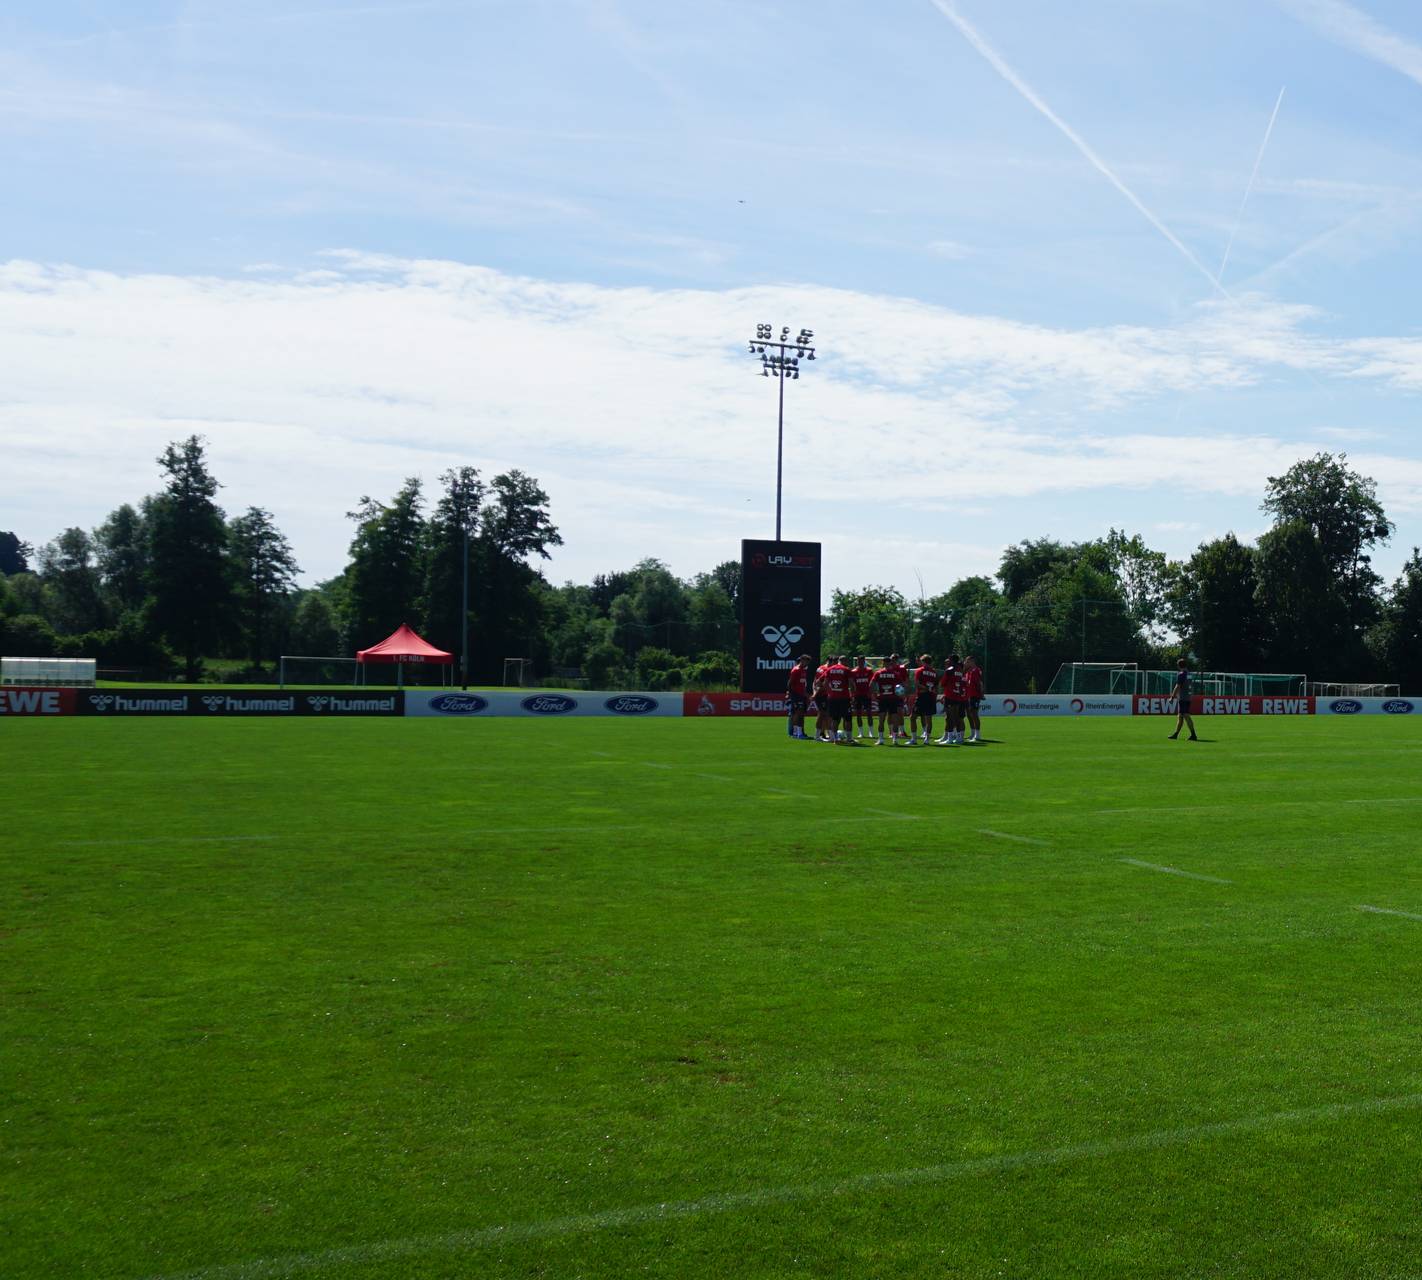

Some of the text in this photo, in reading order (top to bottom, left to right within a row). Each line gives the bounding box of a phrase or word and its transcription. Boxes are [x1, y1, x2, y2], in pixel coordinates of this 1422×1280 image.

[756, 656, 797, 670] humm
[115, 695, 188, 711] hummel
[226, 696, 294, 711] hummel
[330, 696, 395, 711] hummel
[440, 696, 477, 711] Ford
[532, 696, 568, 711] Ford
[615, 696, 647, 711] Ford
[730, 698, 792, 712] SPÜRB
[1137, 698, 1178, 714] REW
[1203, 698, 1250, 714] REWE
[1262, 698, 1309, 714] REWE
